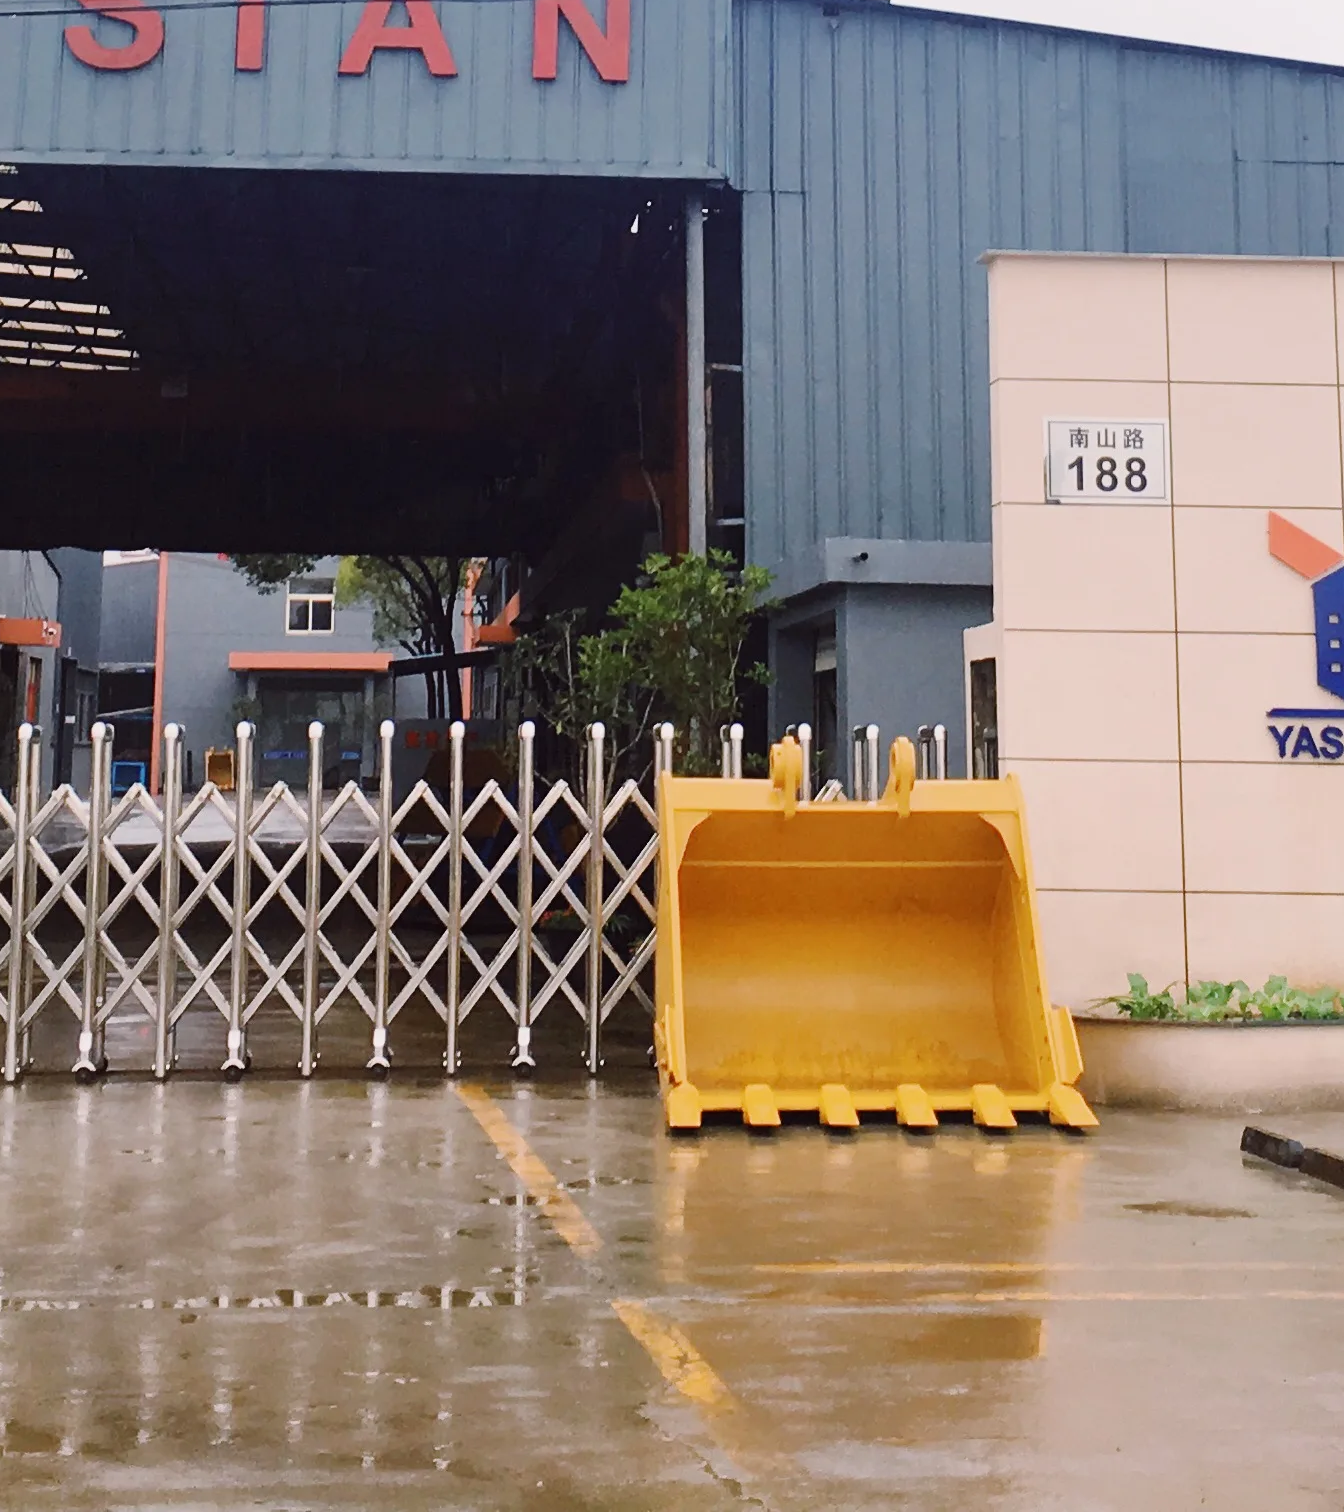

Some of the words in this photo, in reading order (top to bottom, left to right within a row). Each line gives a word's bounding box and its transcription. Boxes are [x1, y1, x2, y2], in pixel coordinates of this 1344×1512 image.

[1069, 427, 1144, 449] 南山路
[1068, 456, 1147, 492] 188
